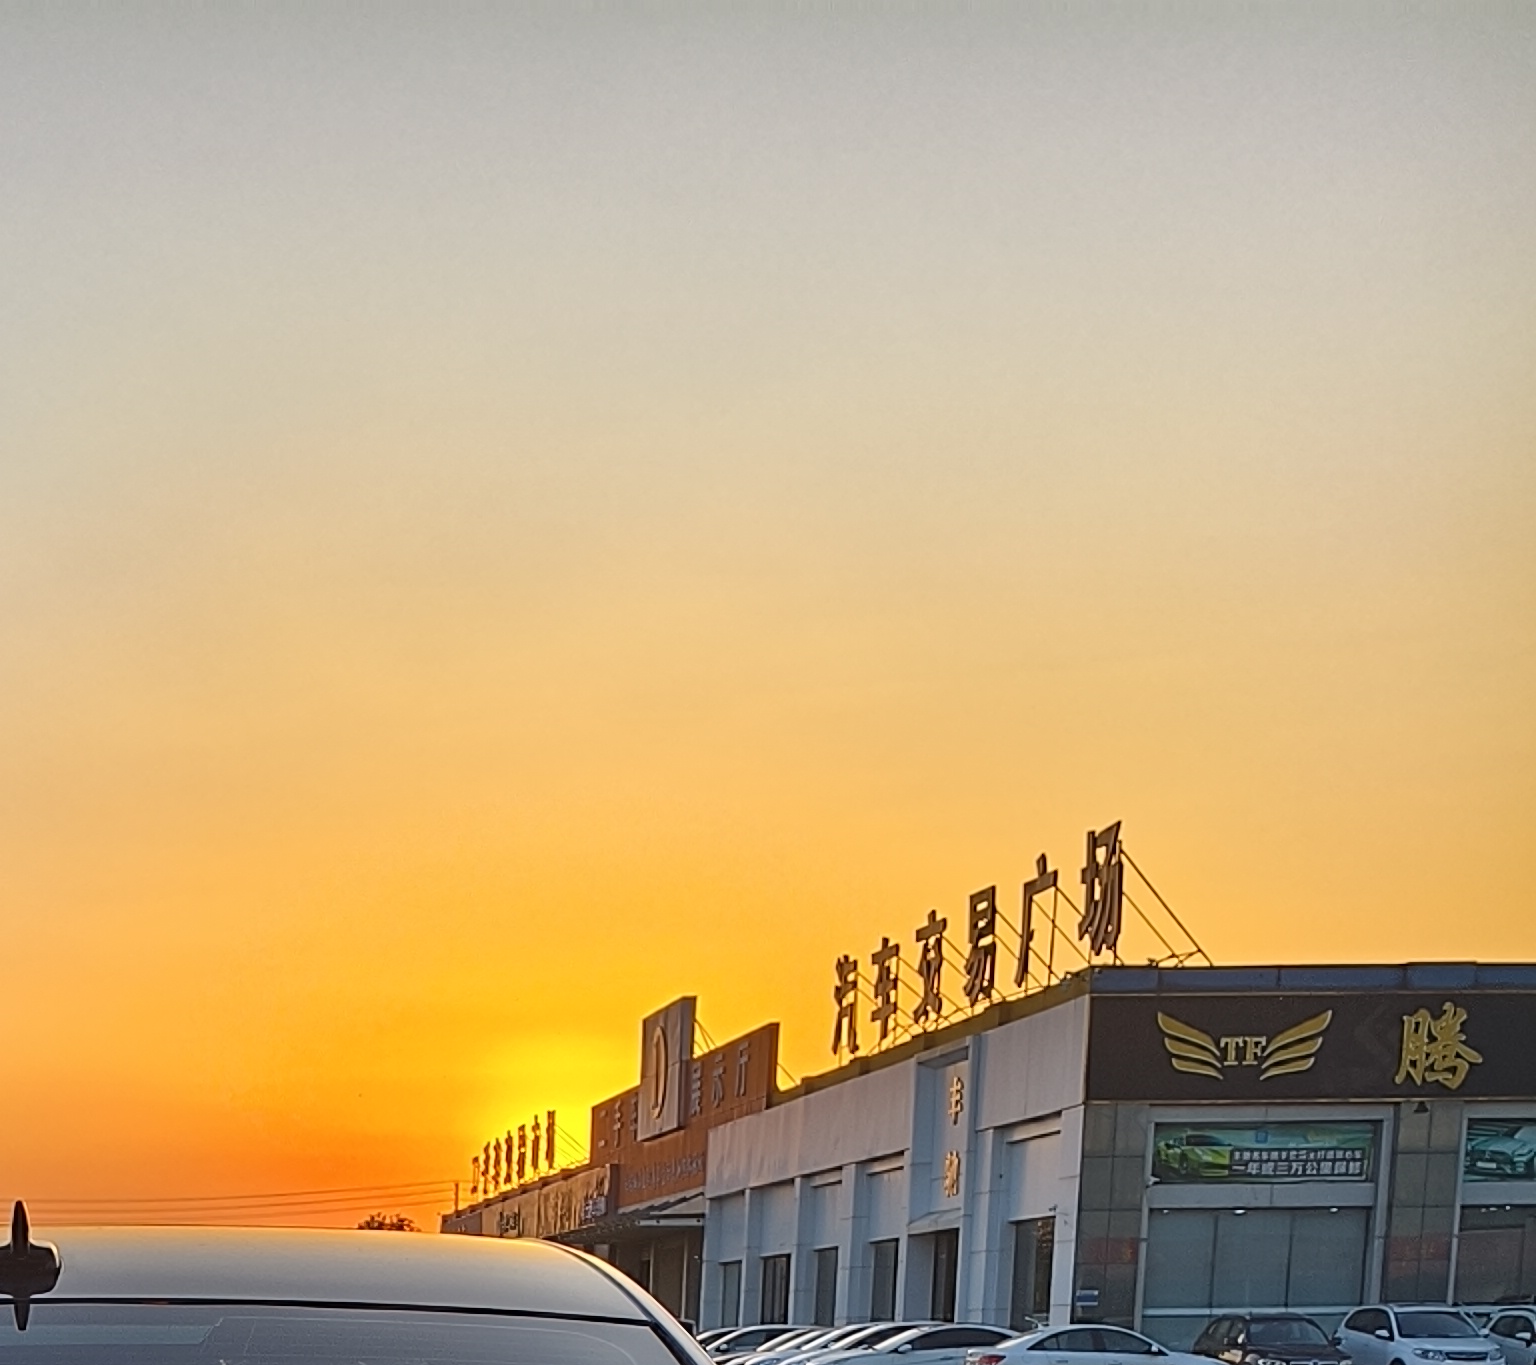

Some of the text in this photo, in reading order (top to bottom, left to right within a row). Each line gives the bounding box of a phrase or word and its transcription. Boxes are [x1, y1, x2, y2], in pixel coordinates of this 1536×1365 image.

[831, 820, 1123, 1055] 汽车交易广场
[689, 1039, 752, 1118] 展示厅
[1219, 1035, 1267, 1067] TF
[1395, 1001, 1483, 1090] 腾
